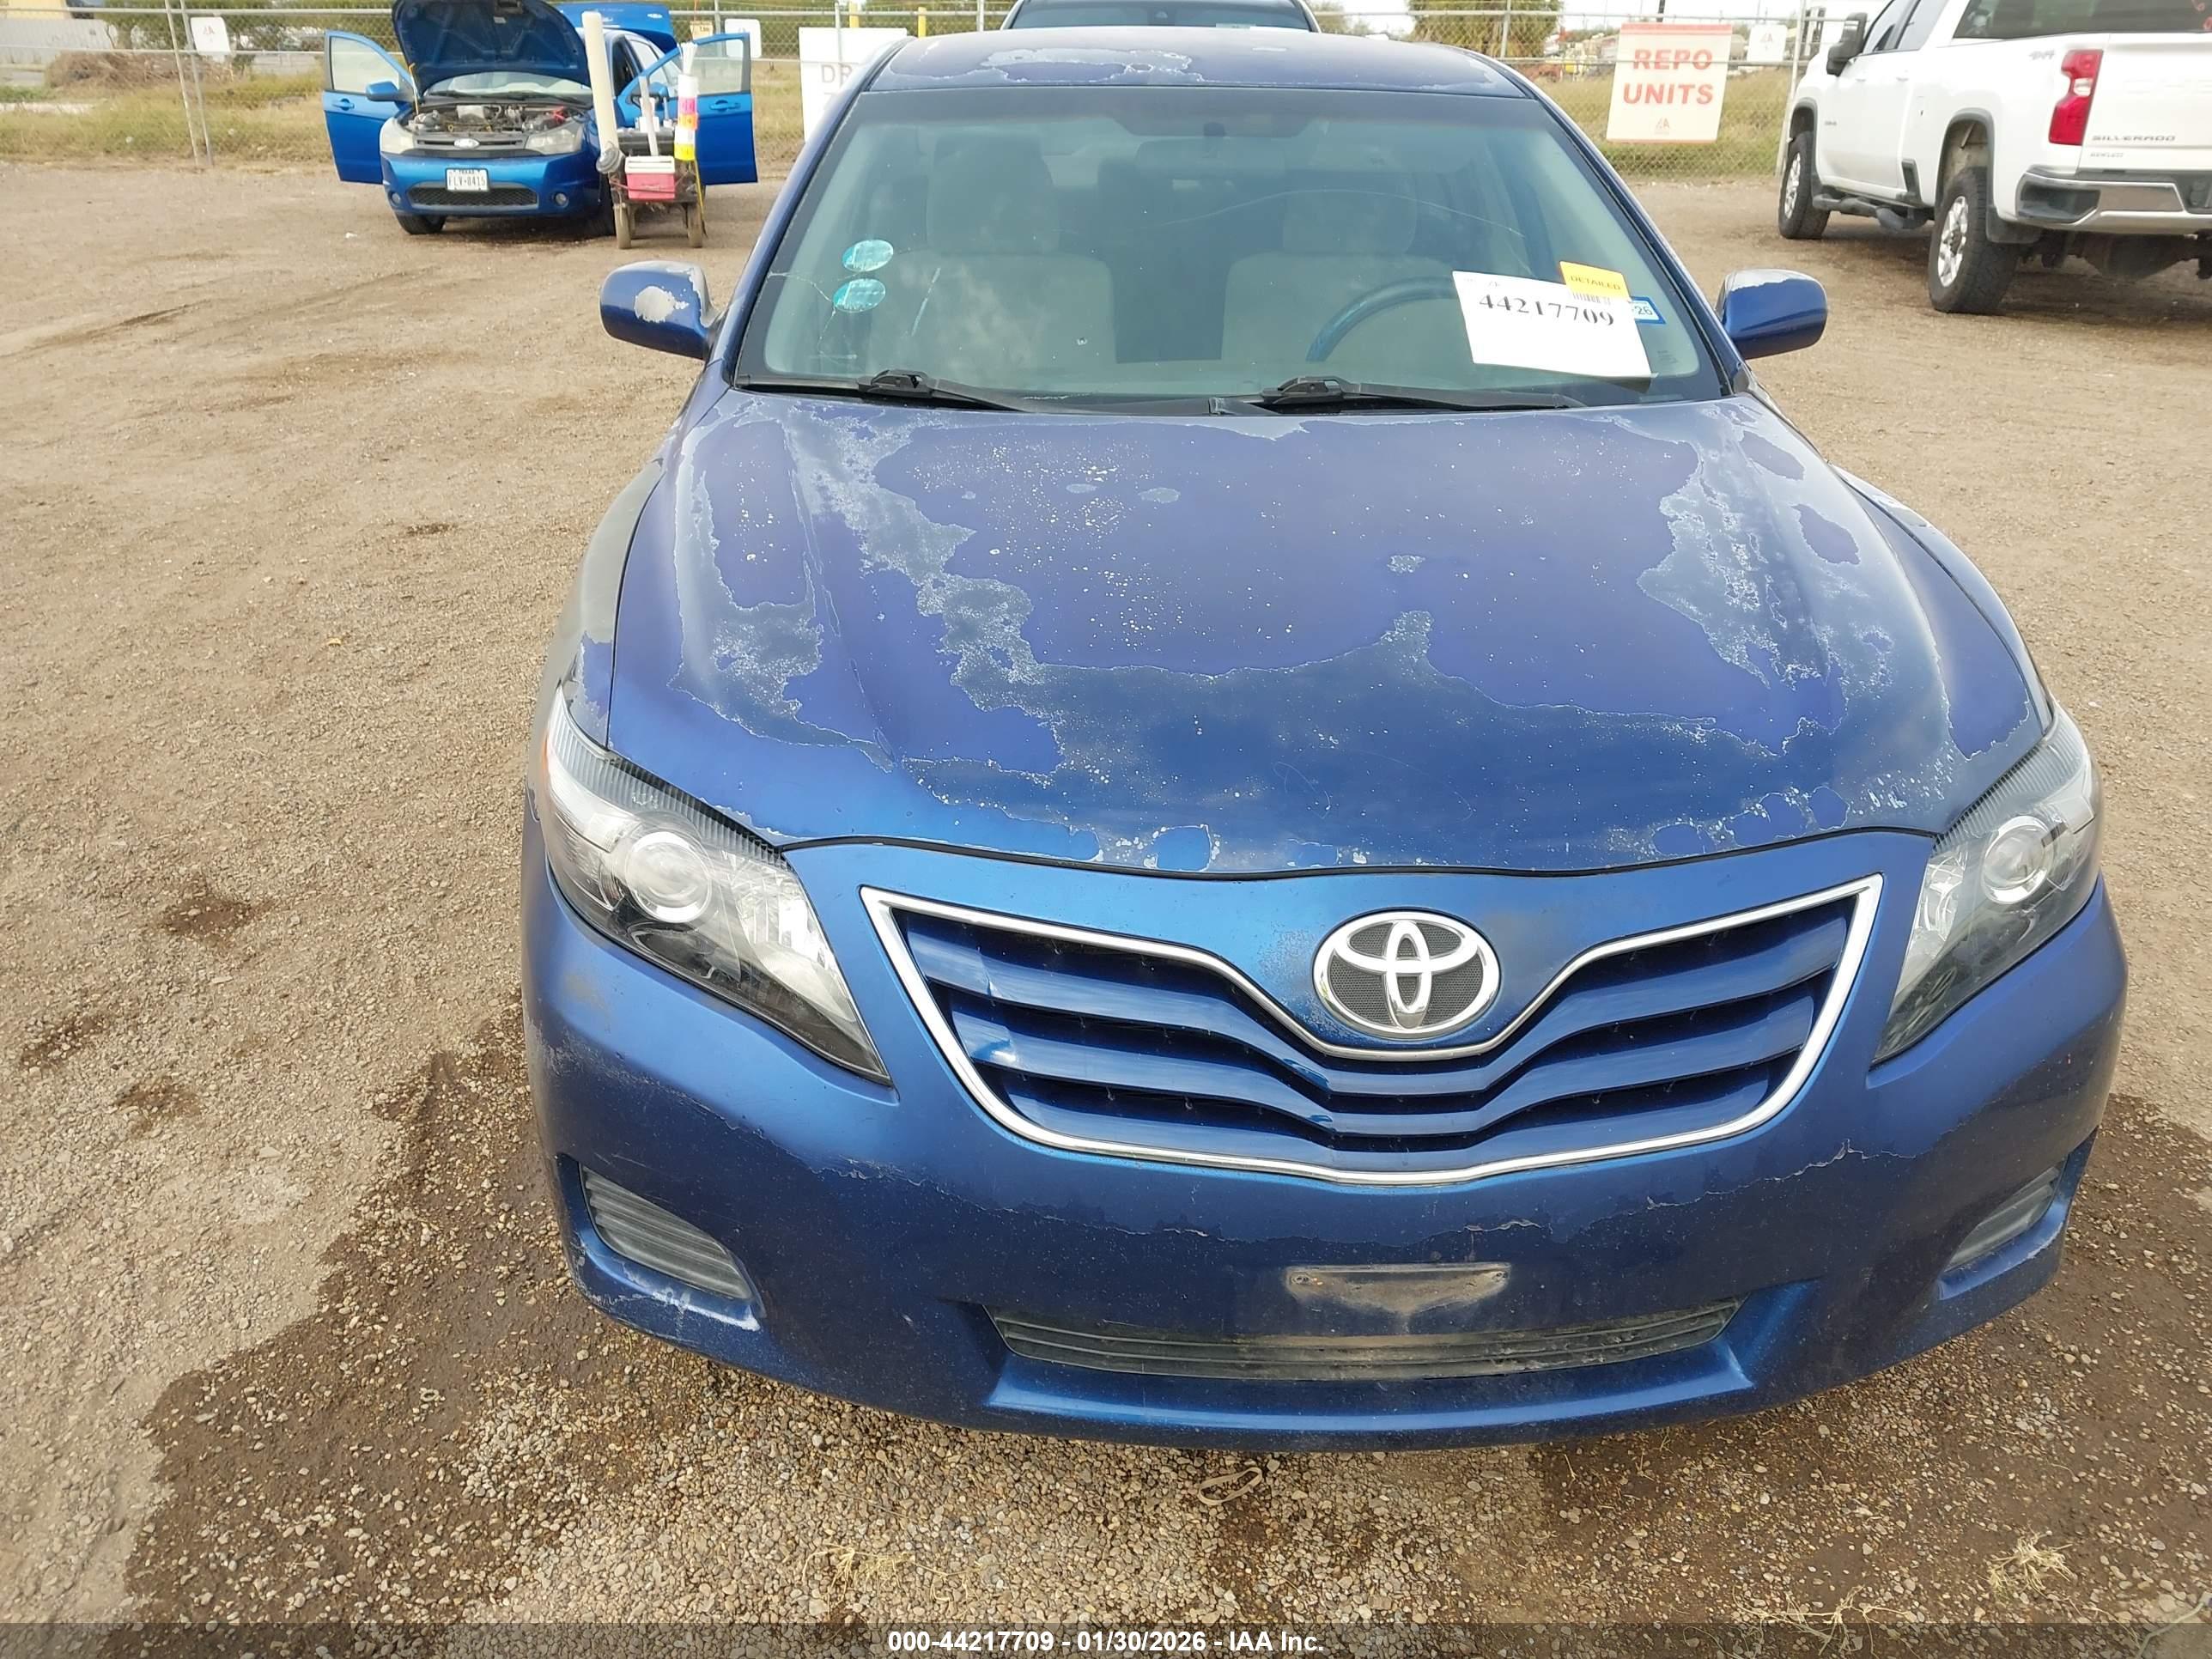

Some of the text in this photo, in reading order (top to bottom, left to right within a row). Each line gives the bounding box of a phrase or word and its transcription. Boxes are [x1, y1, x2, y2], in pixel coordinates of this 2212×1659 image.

[1633, 49, 1713, 70] REPO
[1623, 83, 1714, 105] UNITS
[1571, 275, 1621, 290] DETAILED
[1479, 295, 1614, 326] 44217709
